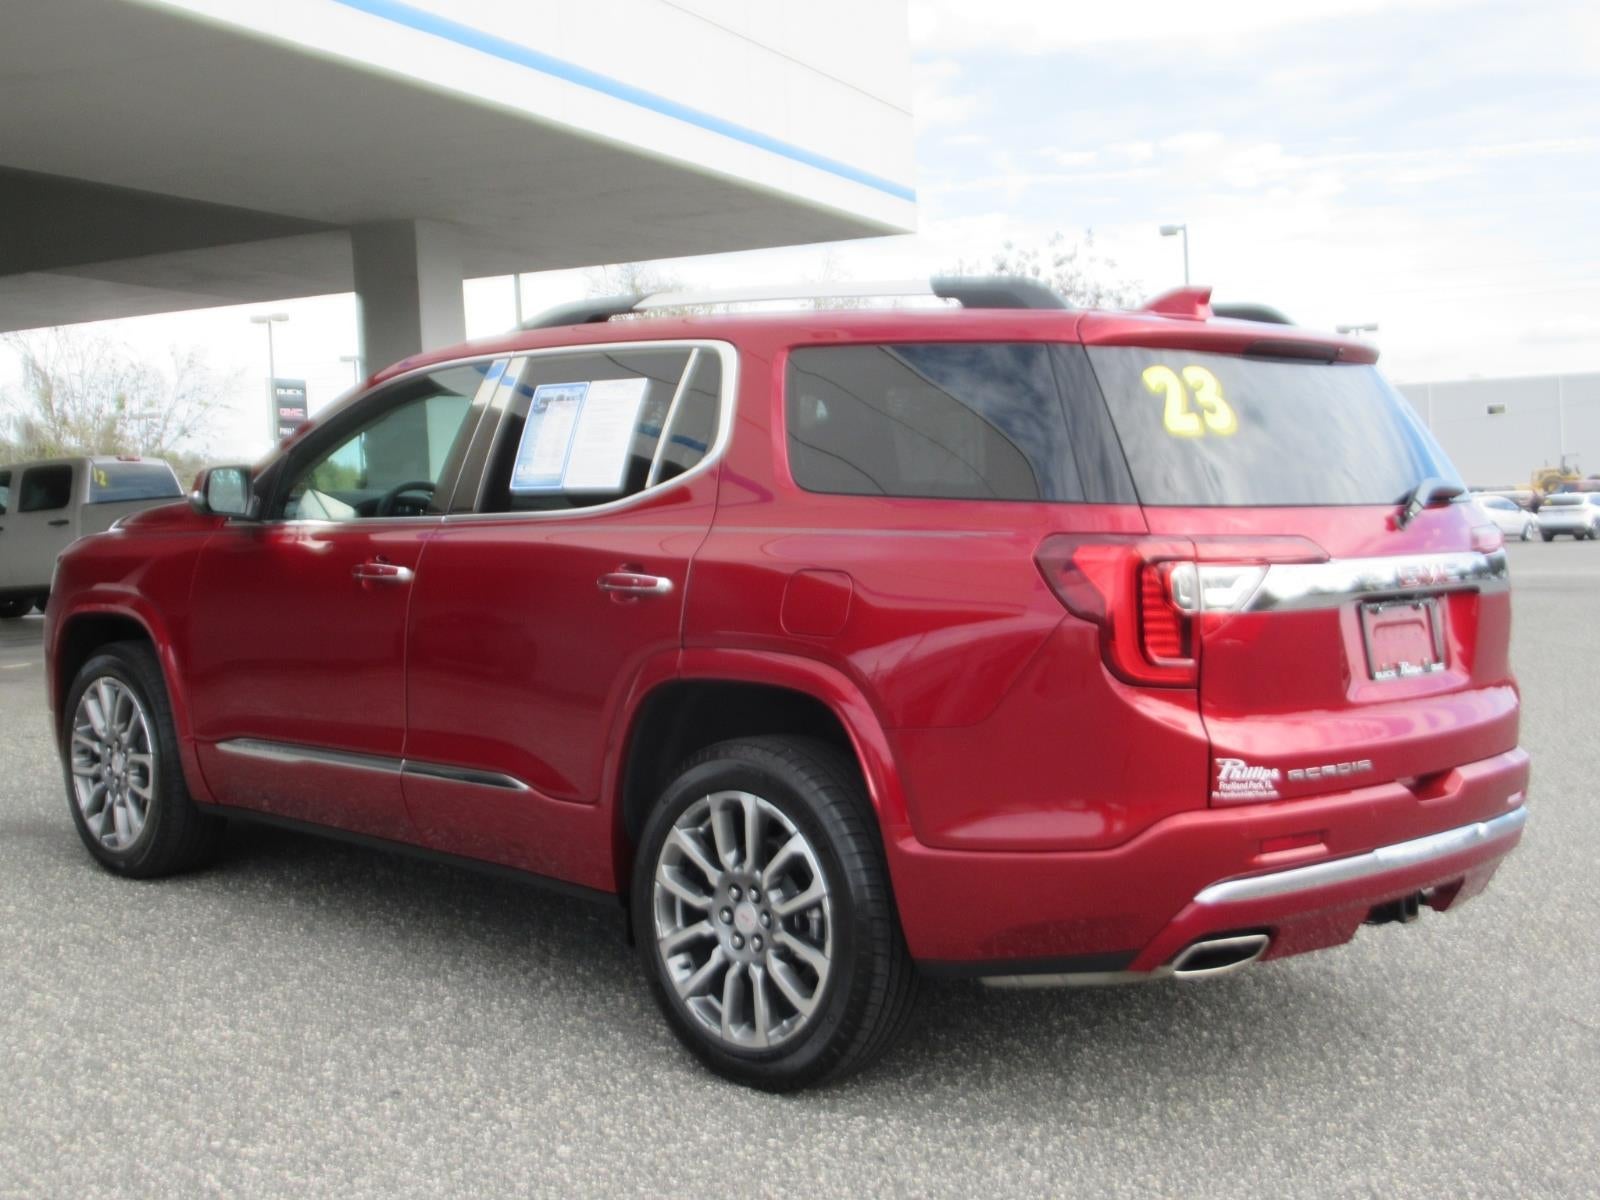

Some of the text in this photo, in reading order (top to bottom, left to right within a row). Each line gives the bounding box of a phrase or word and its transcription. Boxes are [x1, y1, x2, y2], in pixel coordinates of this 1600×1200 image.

[1141, 364, 1238, 436] 23
[279, 407, 304, 417] GMC
[1215, 758, 1280, 781] Phillips
[1288, 759, 1372, 780] ACADIA
